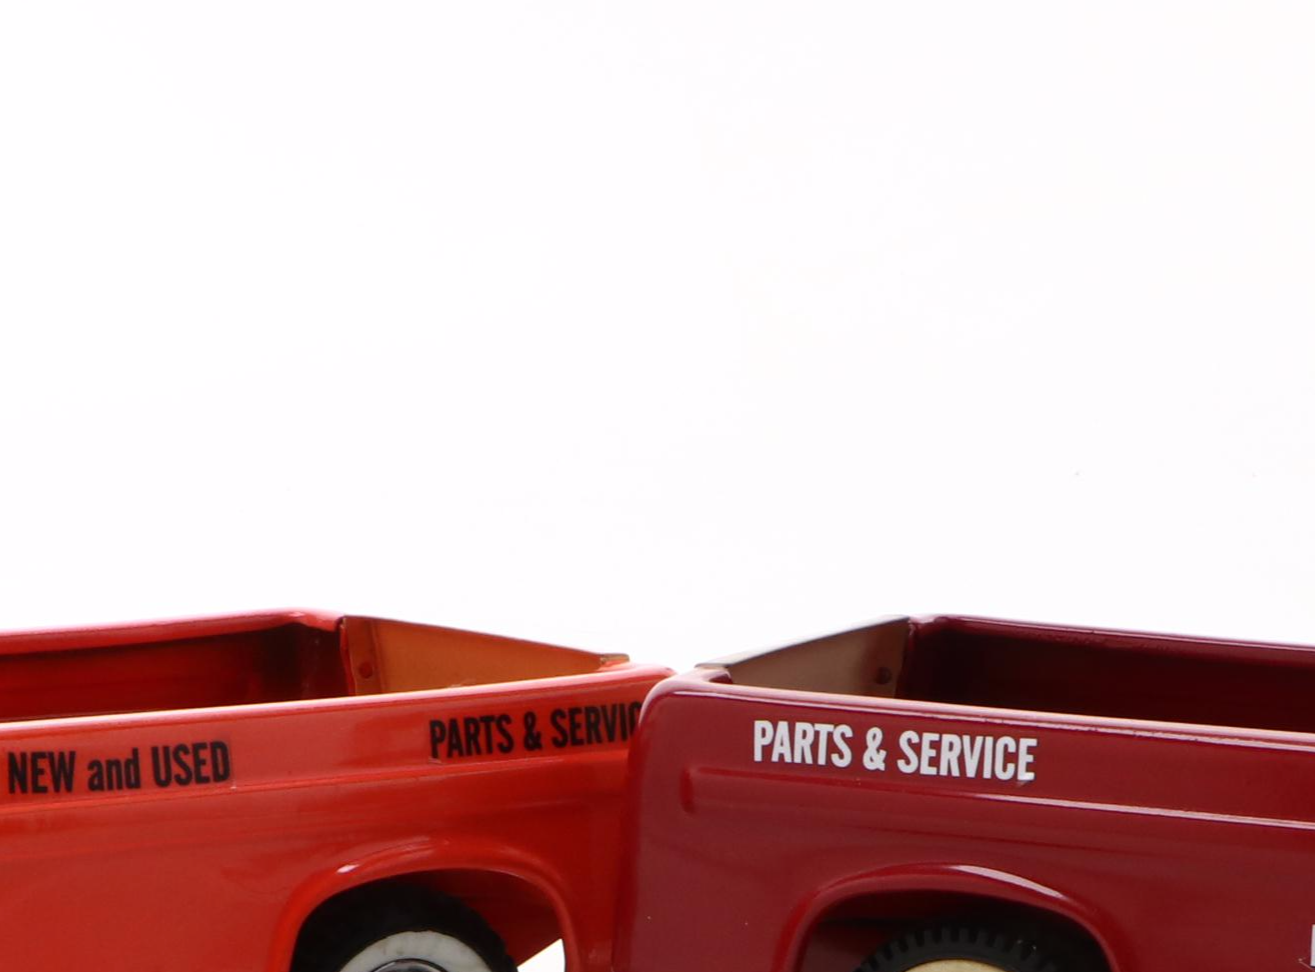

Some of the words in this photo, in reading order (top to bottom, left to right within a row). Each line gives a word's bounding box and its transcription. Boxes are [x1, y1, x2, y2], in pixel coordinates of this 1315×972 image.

[429, 714, 514, 759] PARTS
[523, 711, 542, 752] &
[753, 720, 853, 768] PARTS
[863, 727, 887, 771] &
[897, 730, 1038, 782] SERVICE
[7, 751, 76, 794] NEW
[87, 748, 141, 791] and
[151, 740, 231, 787] USED
